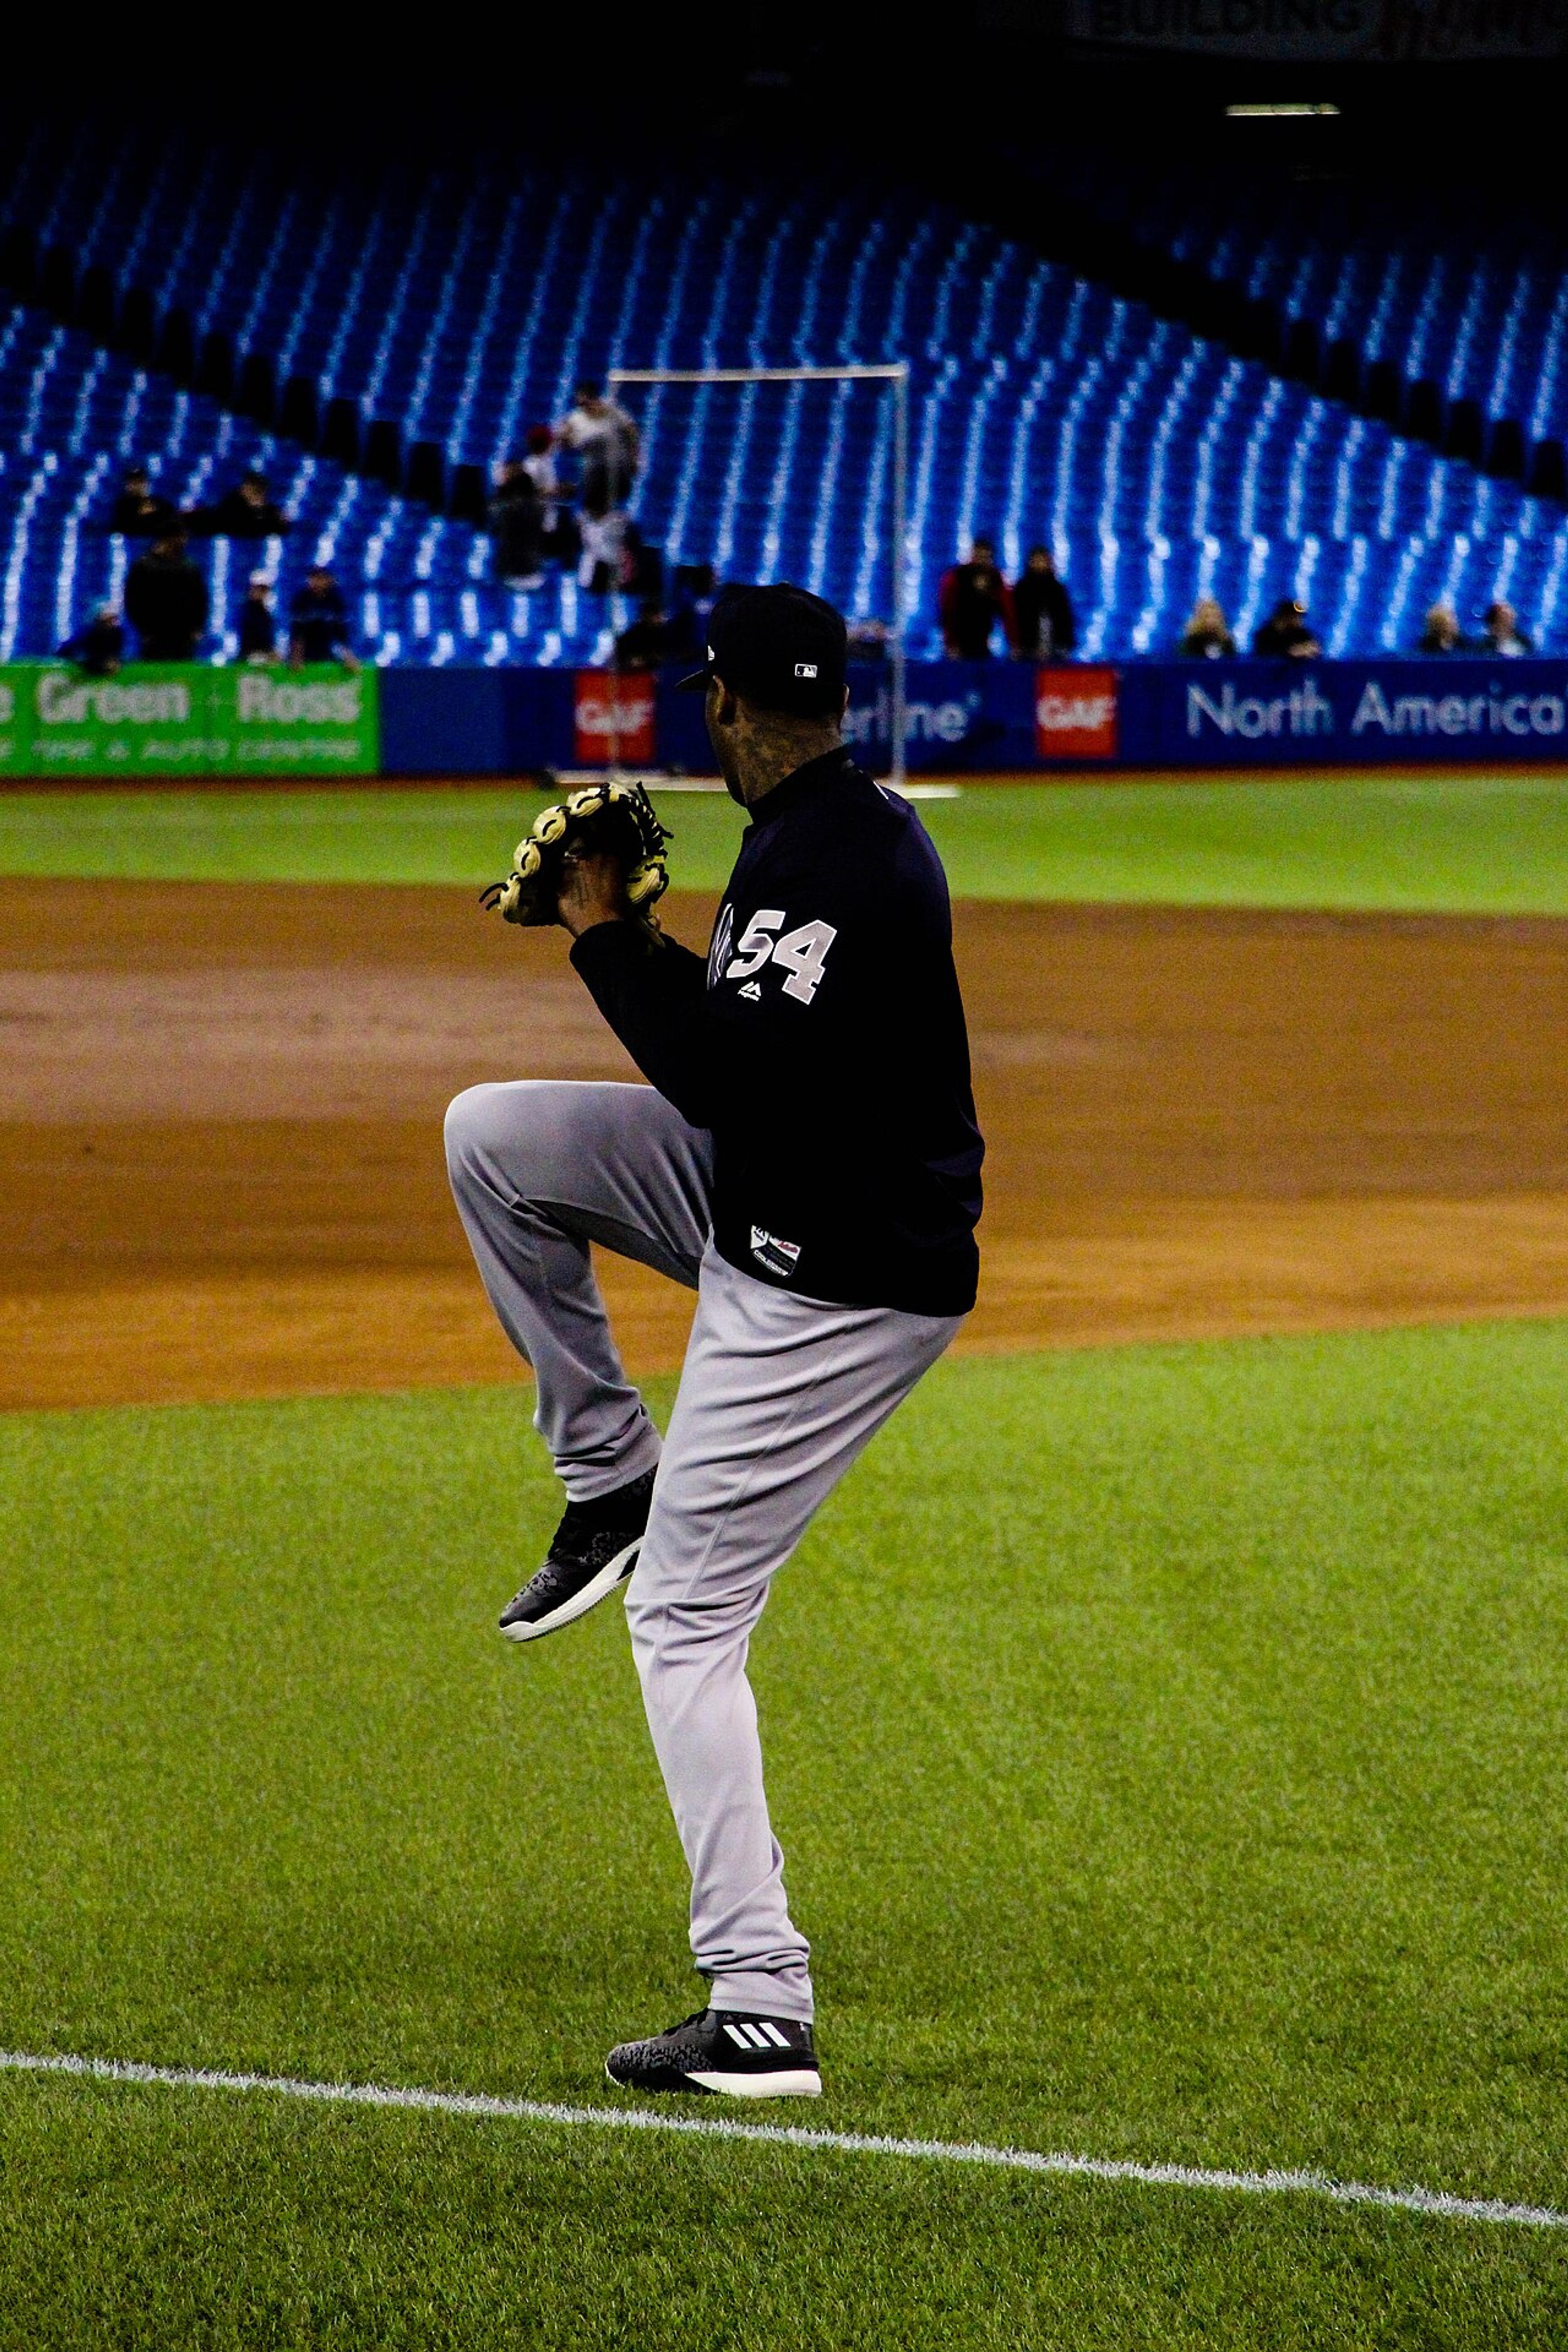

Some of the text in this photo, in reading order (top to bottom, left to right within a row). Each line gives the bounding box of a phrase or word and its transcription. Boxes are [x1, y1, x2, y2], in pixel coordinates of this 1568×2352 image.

[36, 672, 189, 724] Green
[237, 673, 362, 724] Ross
[1187, 675, 1565, 738] North America
[726, 909, 837, 1005] 54
